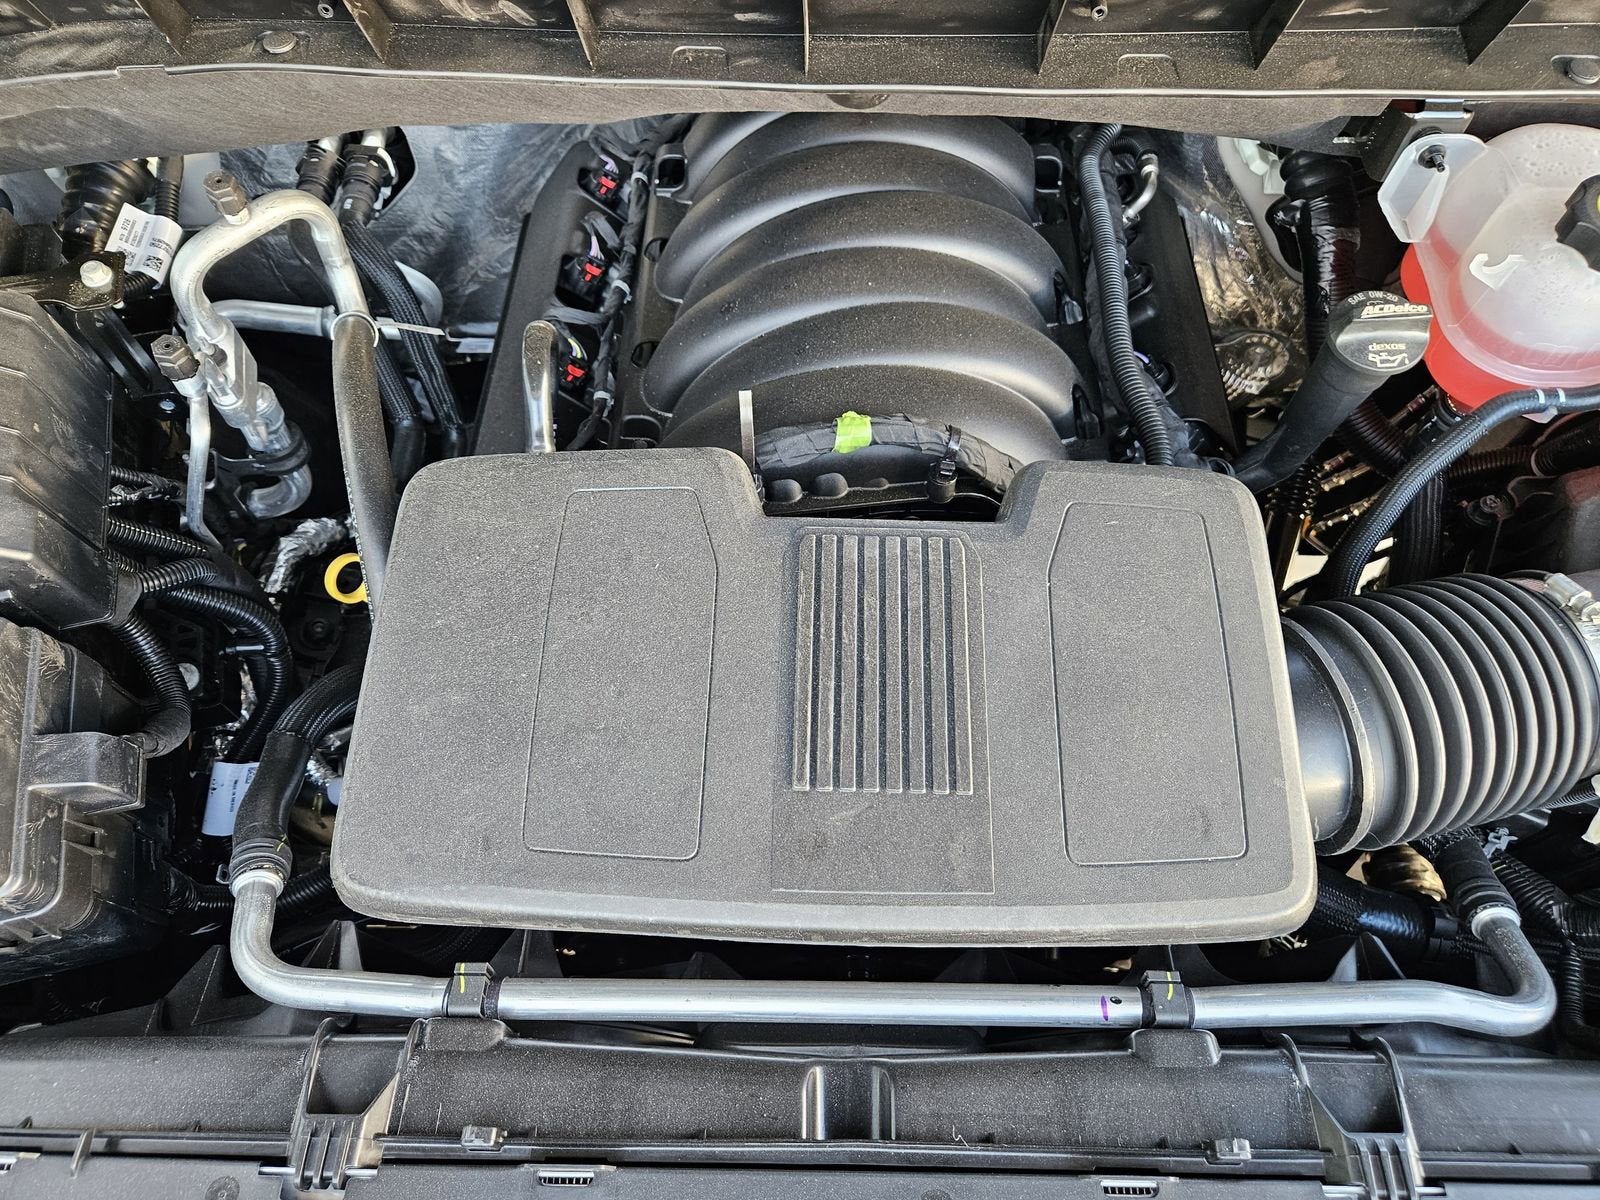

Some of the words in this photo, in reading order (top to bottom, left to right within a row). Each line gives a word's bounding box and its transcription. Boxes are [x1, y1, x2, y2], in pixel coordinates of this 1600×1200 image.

[1347, 292, 1366, 305] SAE
[1368, 290, 1399, 303] 0W-20
[1360, 303, 1428, 316] ACDelco
[1368, 343, 1406, 351] dexos
